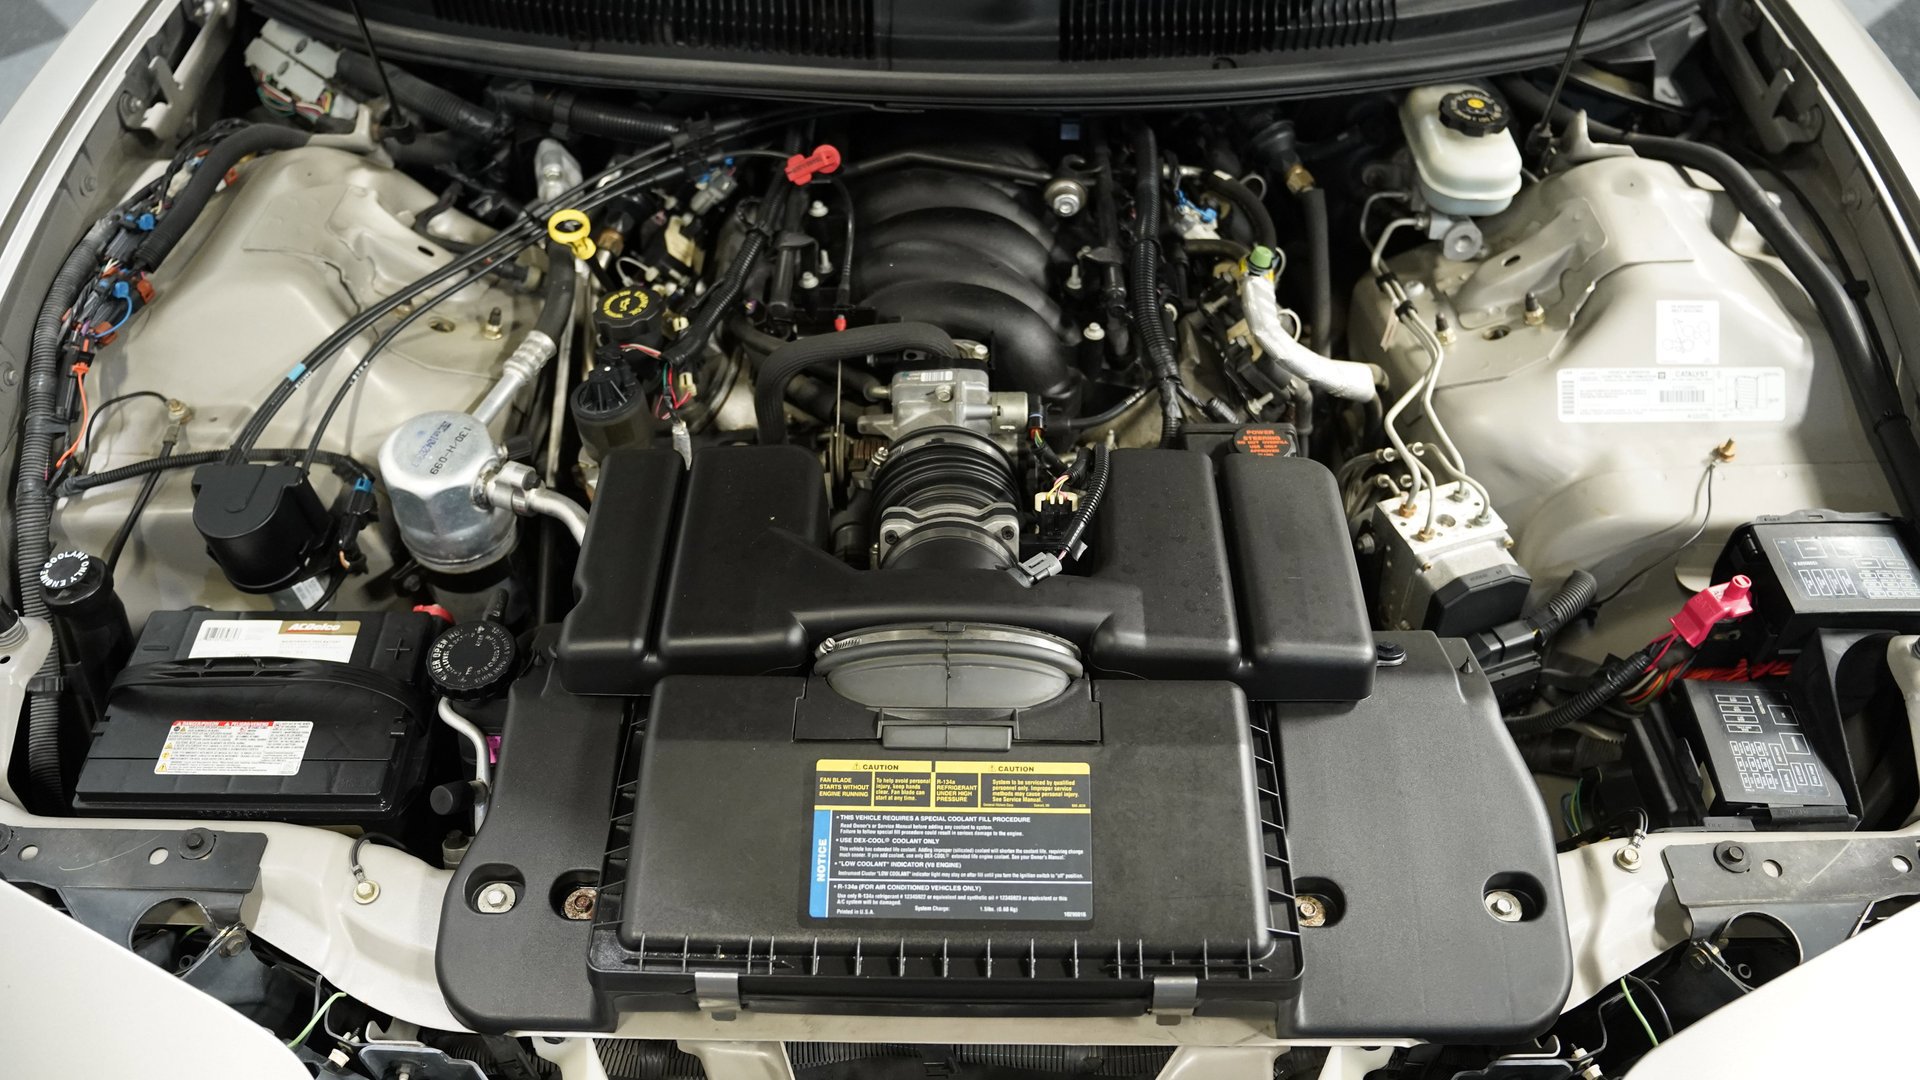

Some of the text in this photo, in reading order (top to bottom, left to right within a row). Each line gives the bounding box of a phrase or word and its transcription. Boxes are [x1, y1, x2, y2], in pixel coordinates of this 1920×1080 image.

[40, 550, 90, 587] ENGINE COOLANT ONLY
[288, 623, 341, 631] ACDelco
[432, 639, 448, 658] OPEN
[816, 838, 828, 882] NOTICE
